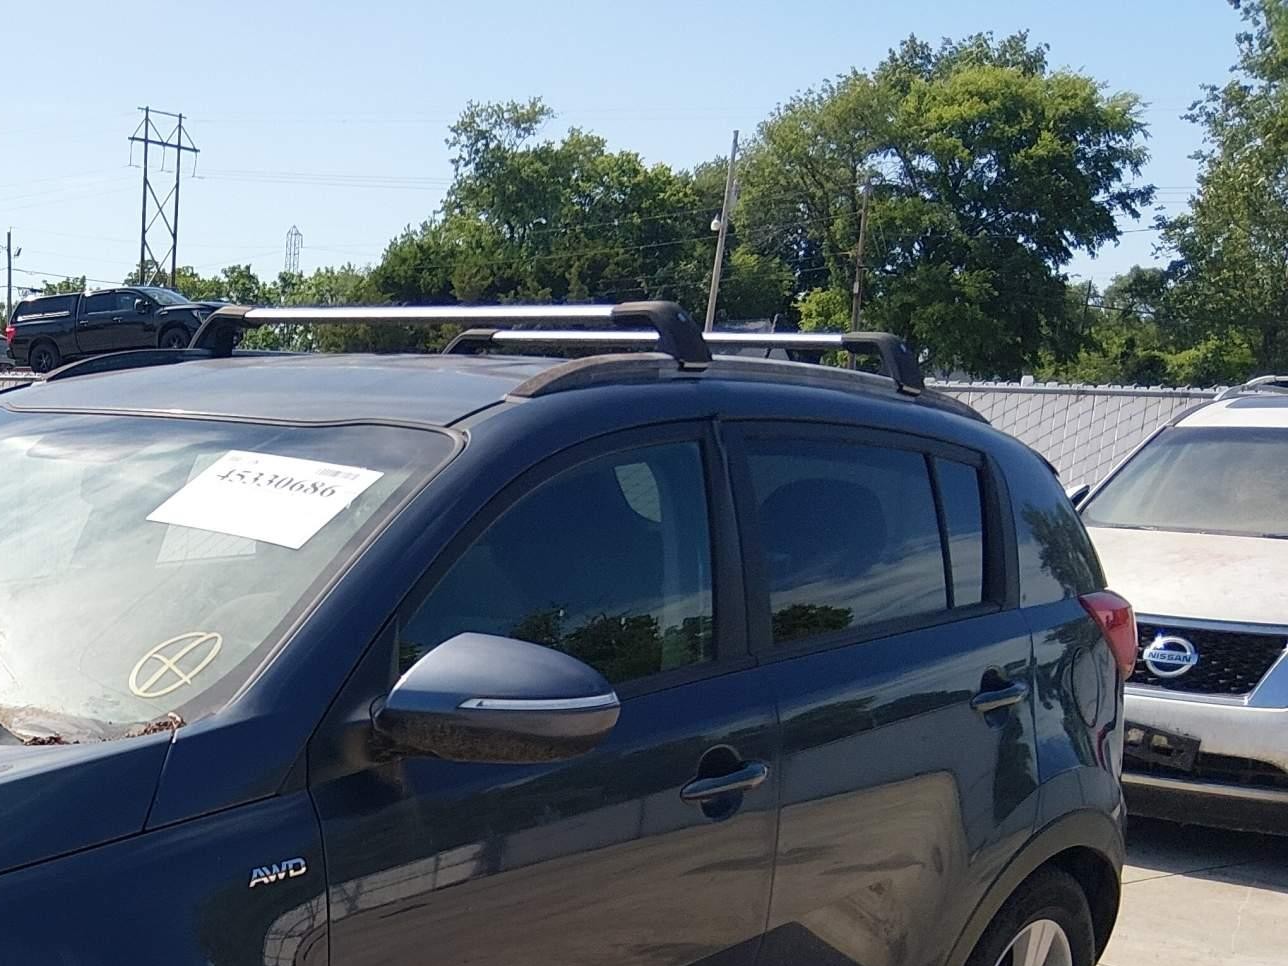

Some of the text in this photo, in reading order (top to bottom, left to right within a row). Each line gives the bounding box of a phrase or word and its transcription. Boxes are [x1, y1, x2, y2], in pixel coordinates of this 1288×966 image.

[216, 468, 337, 498] 45330686
[1148, 651, 1192, 663] NISSAN
[249, 857, 307, 888] AWD
